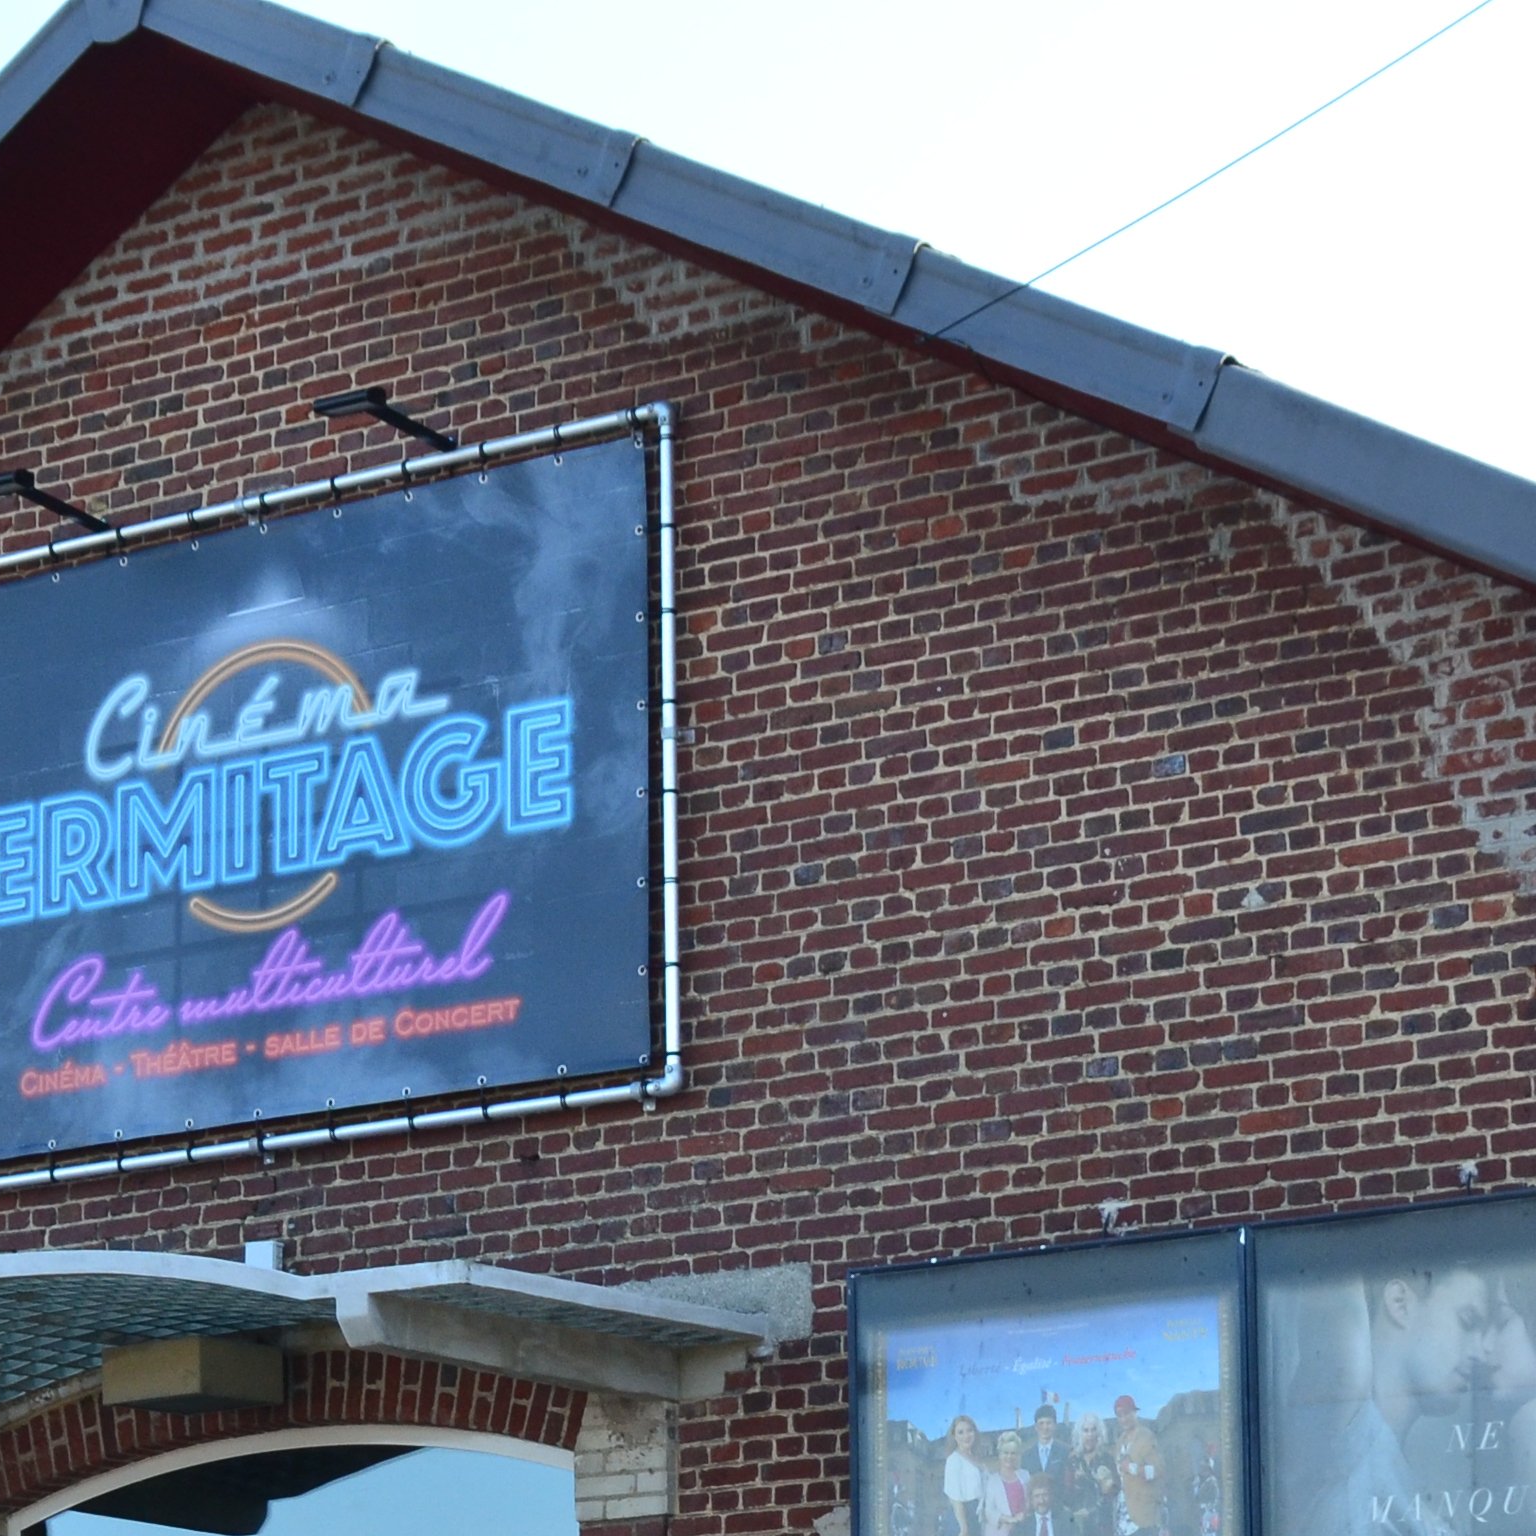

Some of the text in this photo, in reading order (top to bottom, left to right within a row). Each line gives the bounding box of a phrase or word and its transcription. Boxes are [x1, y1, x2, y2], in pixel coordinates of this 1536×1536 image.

[30, 891, 511, 1050] Centre multiculturel
[20, 1057, 107, 1098] CINÉMA
[130, 1040, 238, 1079] THÉÂTRE
[264, 1023, 342, 1060] SALLE
[350, 1016, 387, 1046] DE
[394, 996, 522, 1041] CONCERT
[1446, 1421, 1504, 1452] NE
